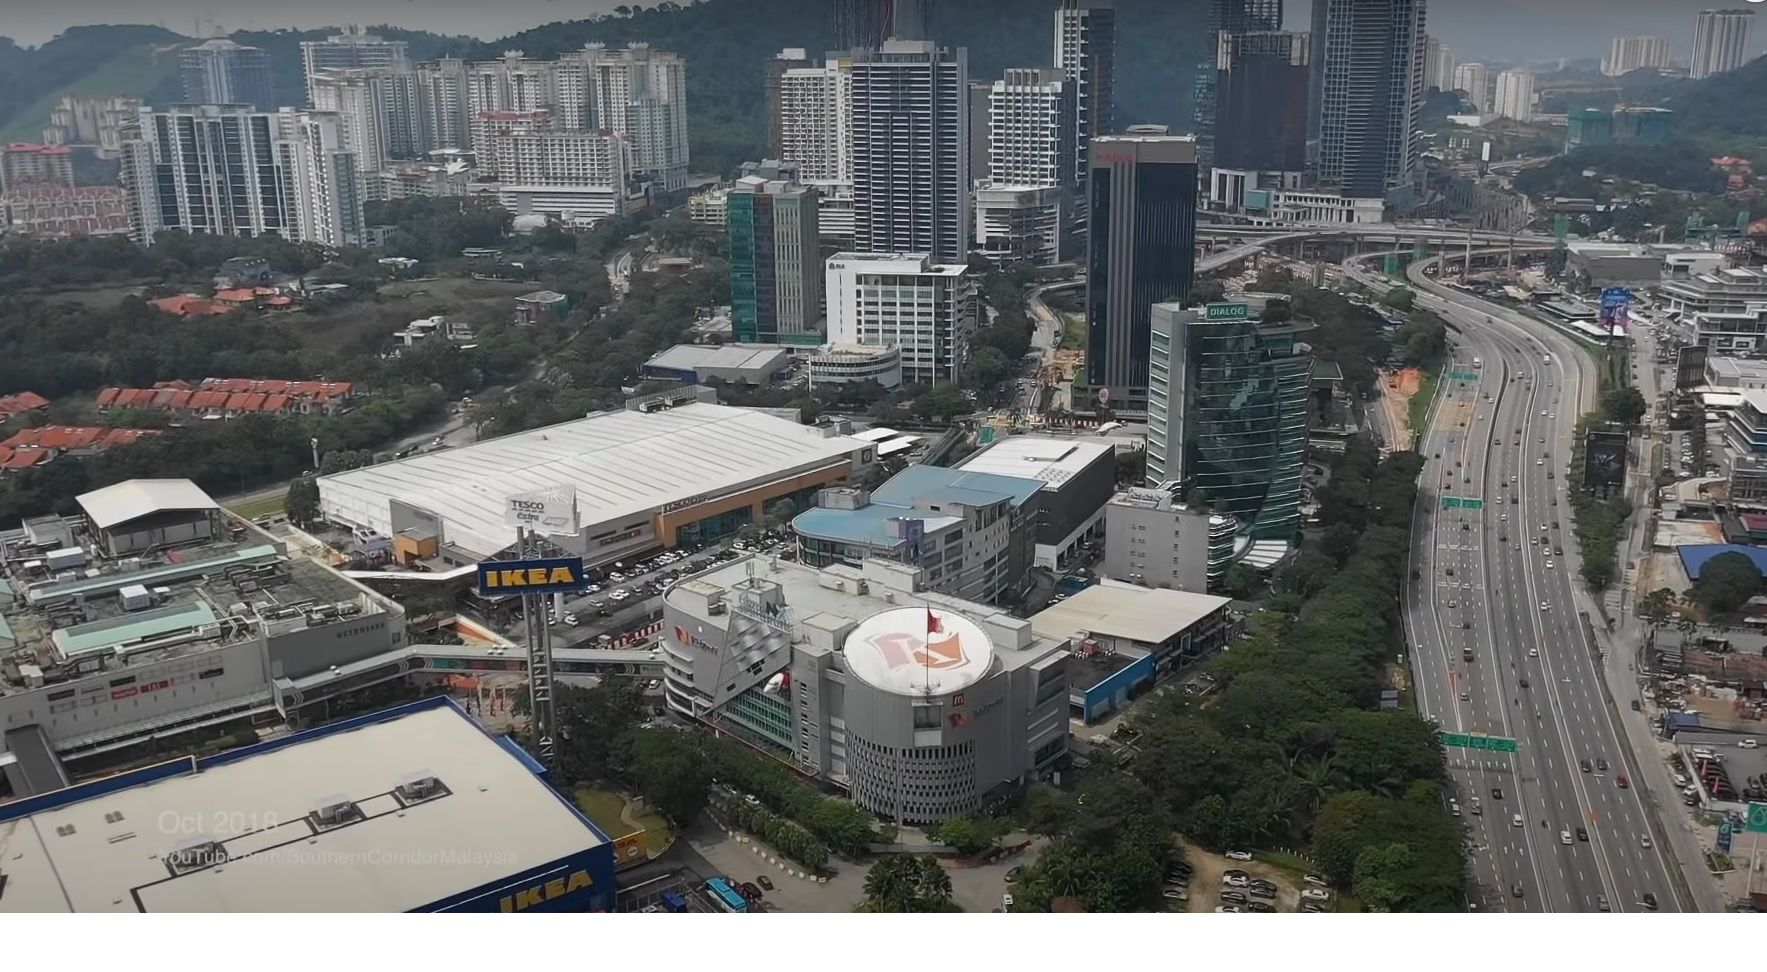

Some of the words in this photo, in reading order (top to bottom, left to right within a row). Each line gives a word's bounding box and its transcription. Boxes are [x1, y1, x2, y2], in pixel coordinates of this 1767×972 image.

[1210, 307, 1244, 316] DIALOG
[510, 499, 545, 511] TESCO
[486, 566, 575, 588] IKEA
[499, 868, 593, 913] IKEA
